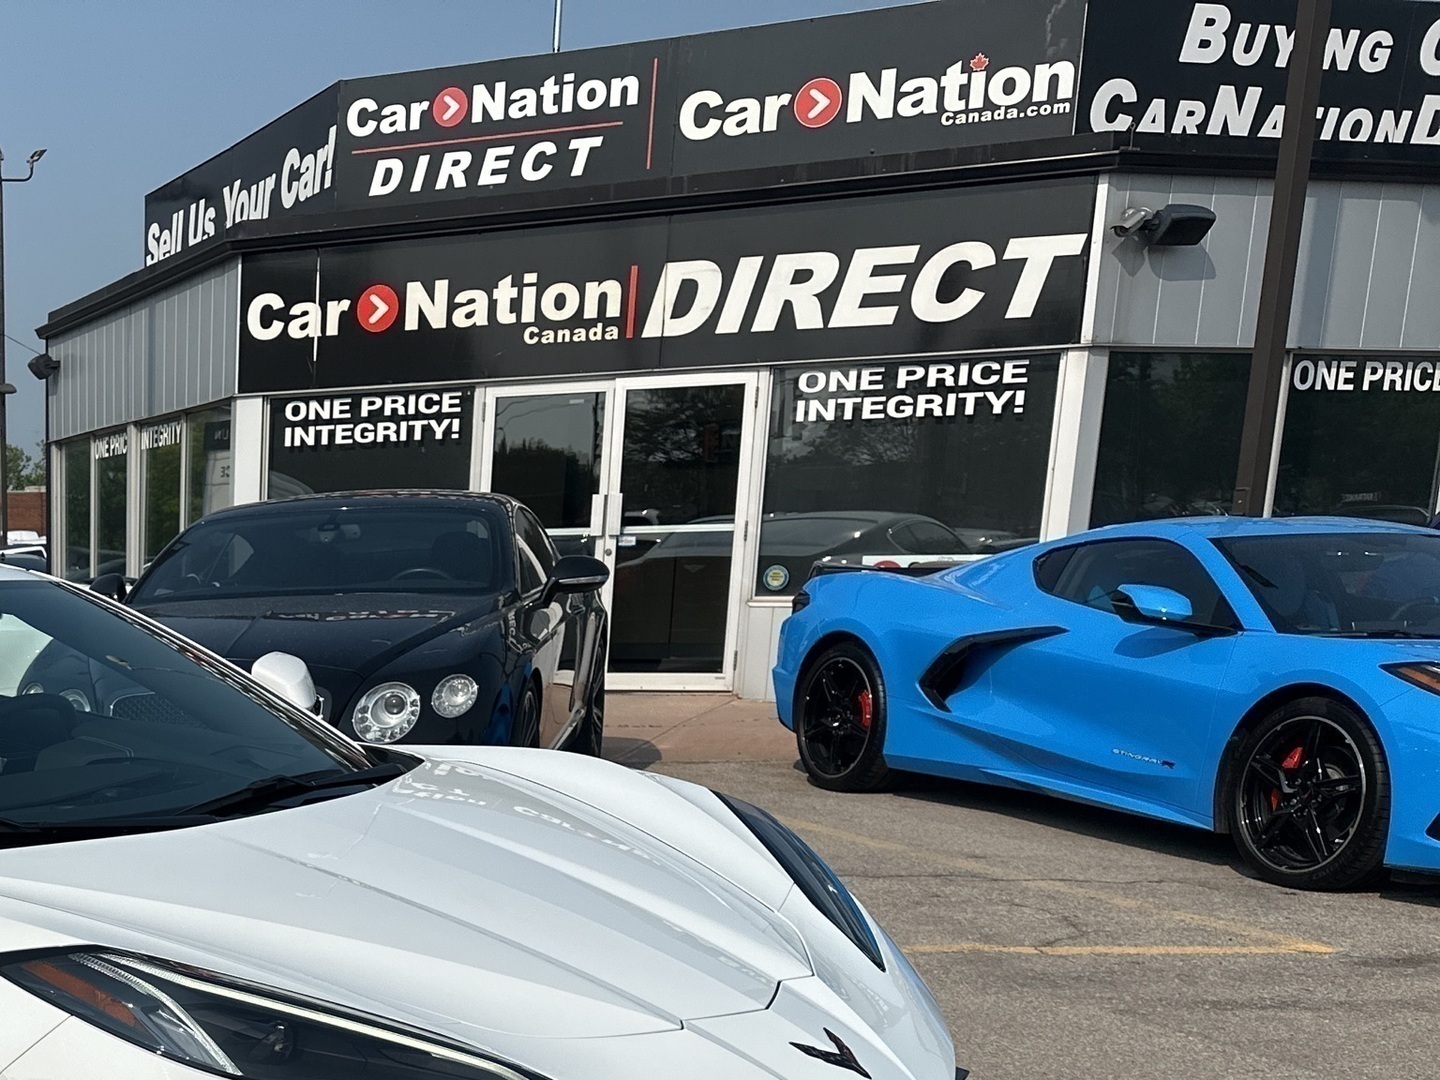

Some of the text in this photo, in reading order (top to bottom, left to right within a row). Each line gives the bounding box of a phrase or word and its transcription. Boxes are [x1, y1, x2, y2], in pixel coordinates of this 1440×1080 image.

[1179, 3, 1393, 72] BUYNG
[347, 73, 638, 136] Car Nation
[680, 57, 1075, 140] Car Nation
[941, 102, 1070, 125] Canada.com
[369, 136, 603, 196] DIRECT
[146, 124, 337, 267] Sell Us Your Car!
[247, 233, 1088, 340] Car Nation DIRECT
[524, 323, 618, 344] Canada
[799, 360, 1030, 393] ONE PRICE
[1294, 361, 1356, 390] ONE
[284, 391, 461, 421] ONE PRICE
[795, 390, 1026, 422] INTEGRITY!
[95, 436, 109, 460] ONE
[110, 432, 128, 456] PRIC
[284, 418, 460, 446] INTEGRITY!
